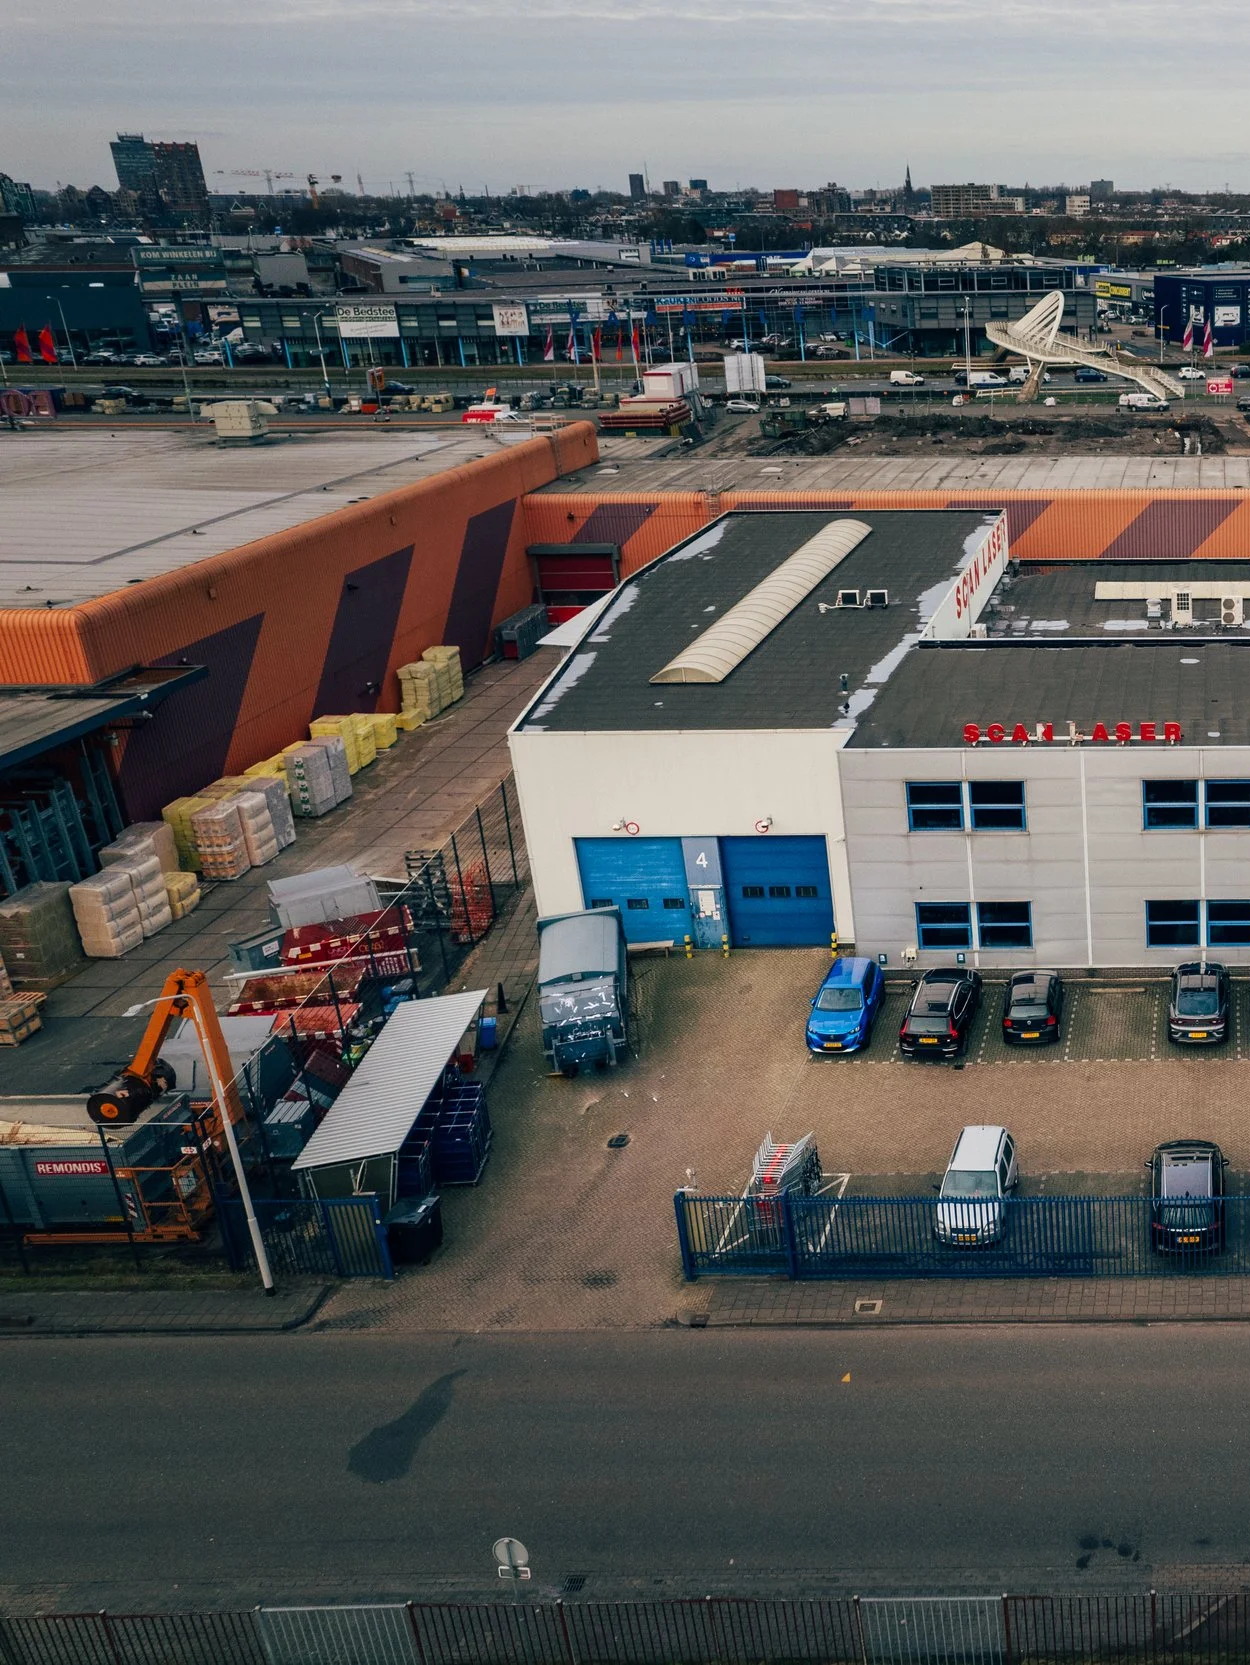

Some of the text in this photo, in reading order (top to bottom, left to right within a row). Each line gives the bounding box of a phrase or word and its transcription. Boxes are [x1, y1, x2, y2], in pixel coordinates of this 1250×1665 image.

[140, 251, 159, 259] KOM
[337, 307, 395, 316] De Bedstee
[955, 517, 1006, 619] SCAN LASER
[963, 722, 1053, 743] SCAN
[696, 852, 708, 868] 4
[36, 1161, 102, 1174] REMONDIS
